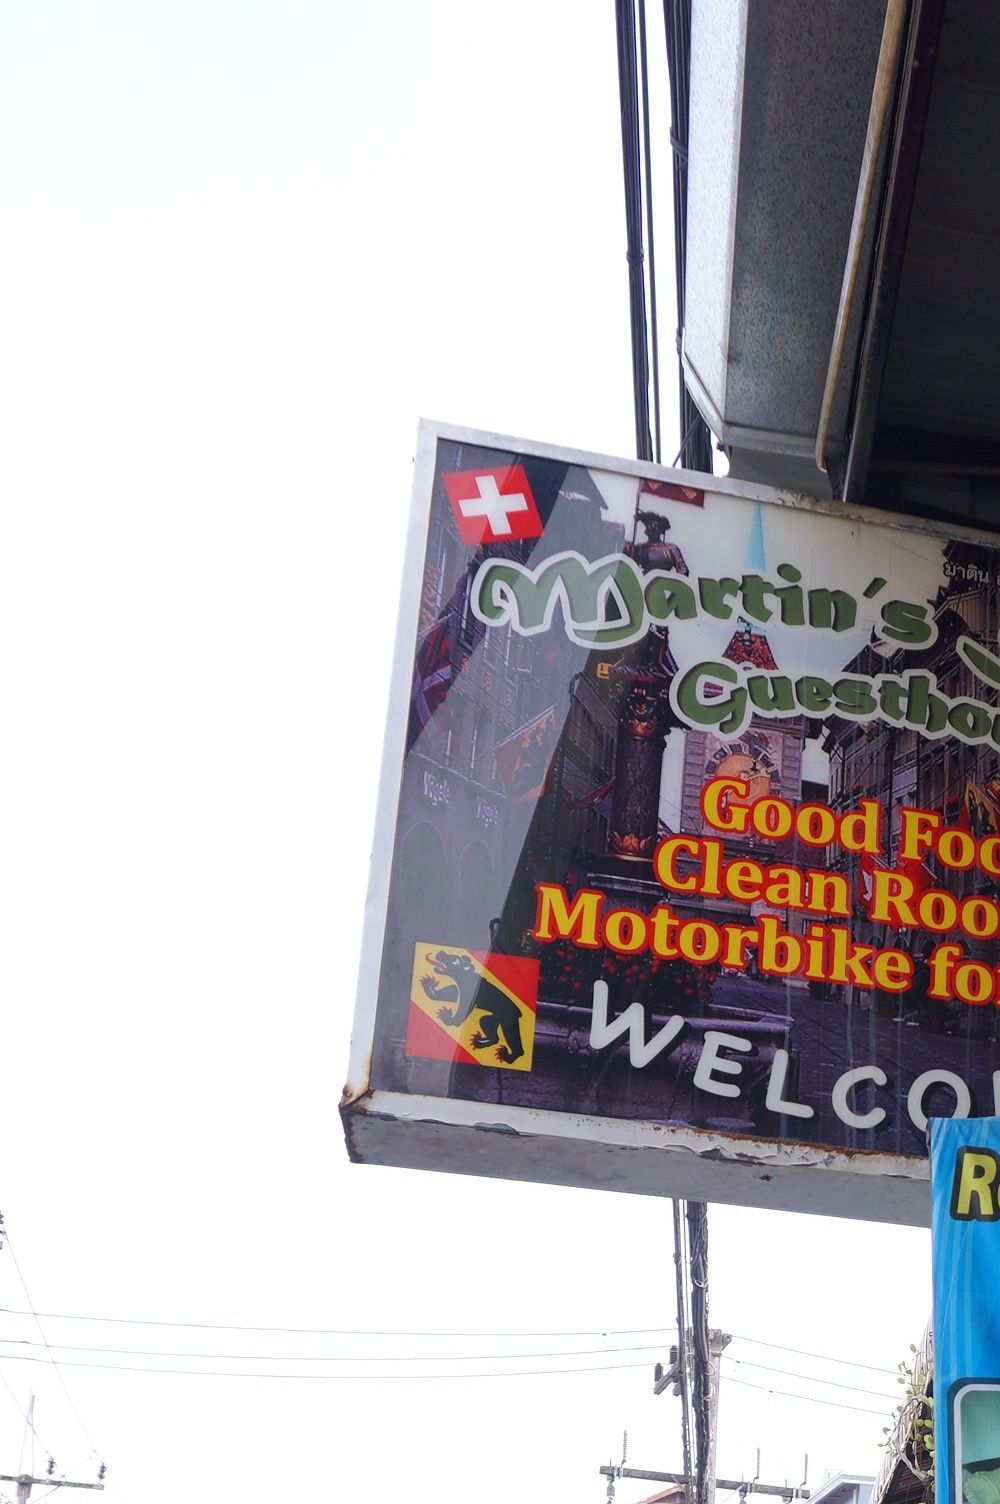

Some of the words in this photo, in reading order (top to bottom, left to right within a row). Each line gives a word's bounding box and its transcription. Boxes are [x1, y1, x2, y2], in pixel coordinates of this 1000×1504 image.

[471, 550, 938, 650] Martin's
[701, 778, 883, 855] Good
[655, 836, 851, 916] Clean
[534, 884, 912, 991] Motorbike
